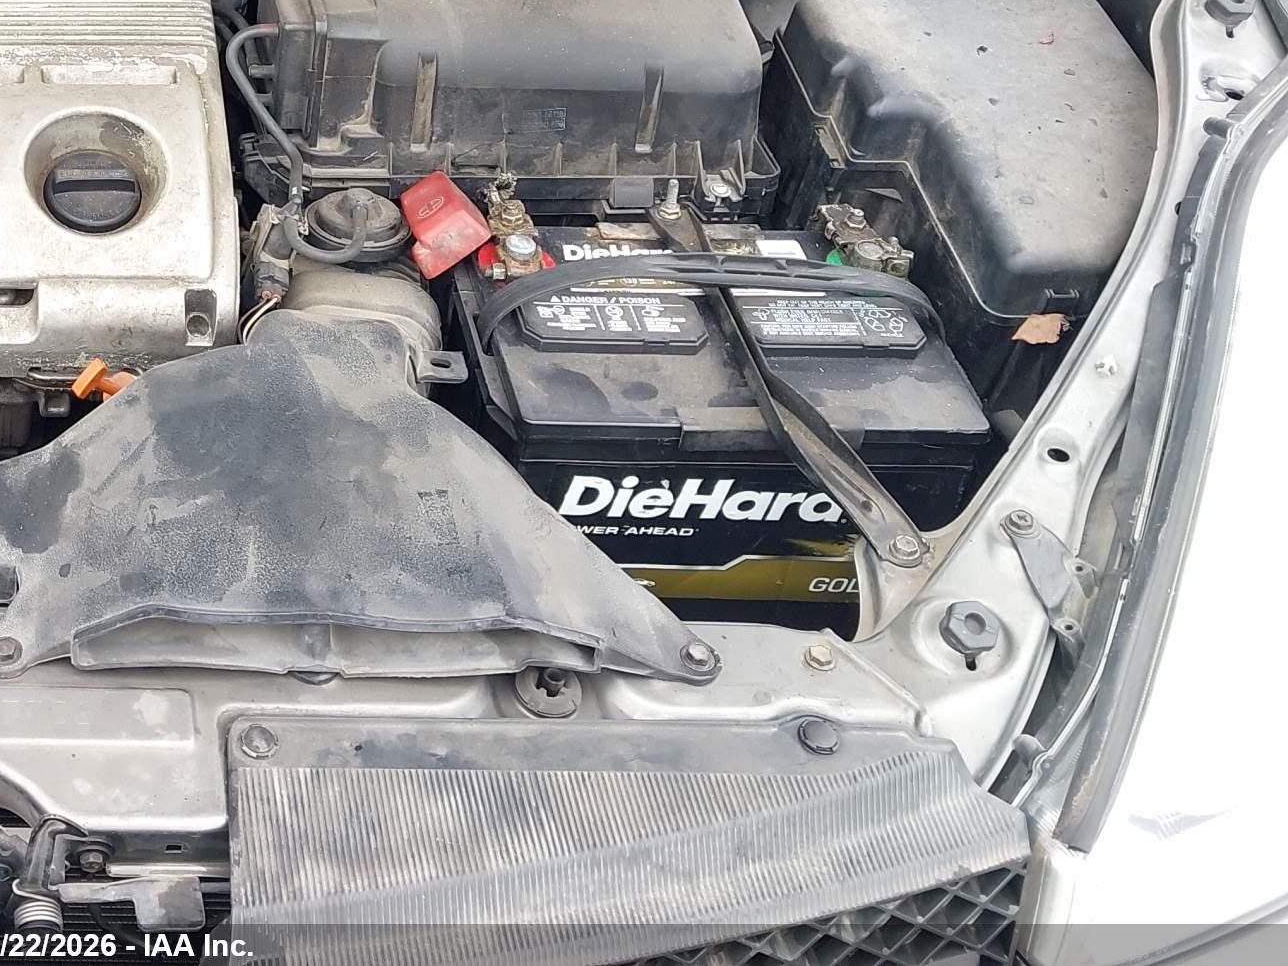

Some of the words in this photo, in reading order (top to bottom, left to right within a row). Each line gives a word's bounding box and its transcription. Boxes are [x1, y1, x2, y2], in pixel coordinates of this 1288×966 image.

[560, 295, 609, 304] DANGER
[618, 297, 661, 305] POISON
[575, 524, 619, 535] WER
[624, 526, 694, 537] AHEAD
[808, 577, 860, 593] GOL
